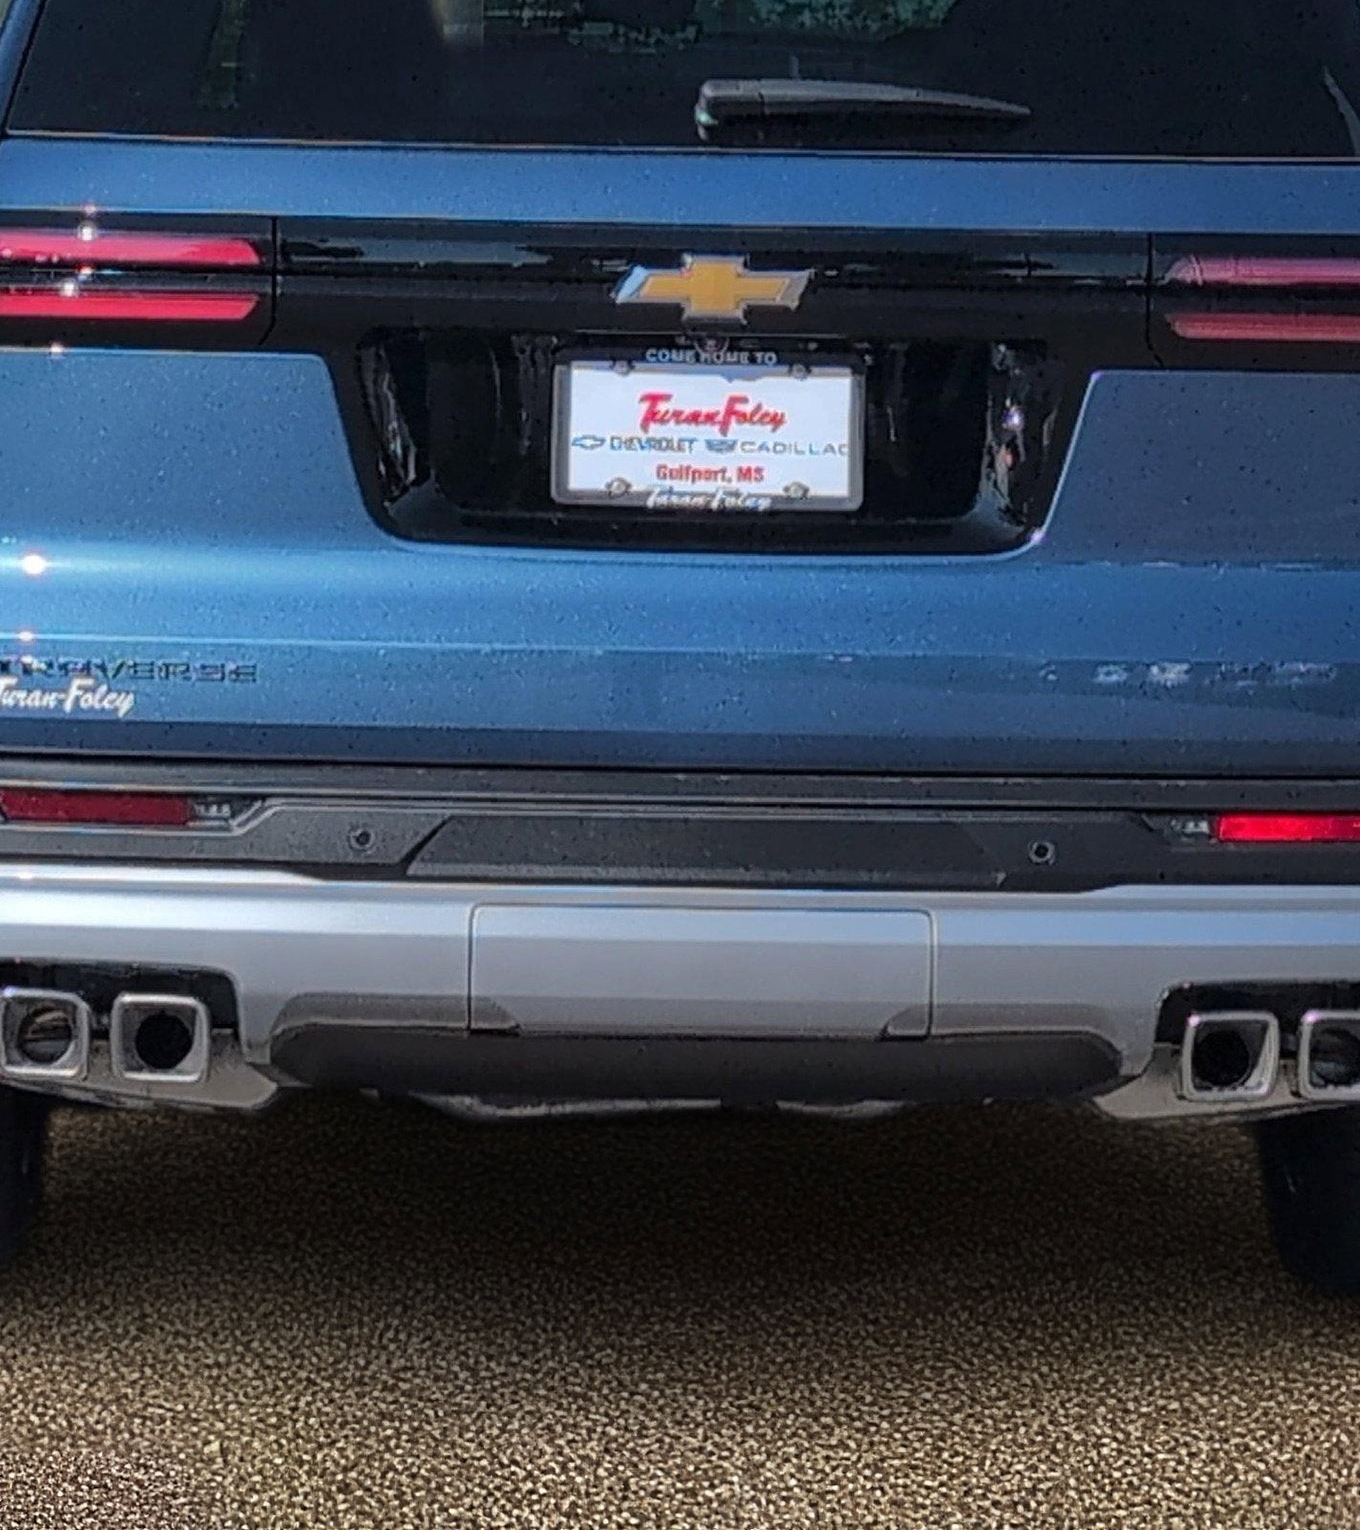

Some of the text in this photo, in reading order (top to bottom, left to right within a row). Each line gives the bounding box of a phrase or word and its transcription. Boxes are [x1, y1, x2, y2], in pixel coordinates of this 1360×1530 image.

[753, 351, 778, 365] TO
[656, 464, 765, 483] Gulfport, MS
